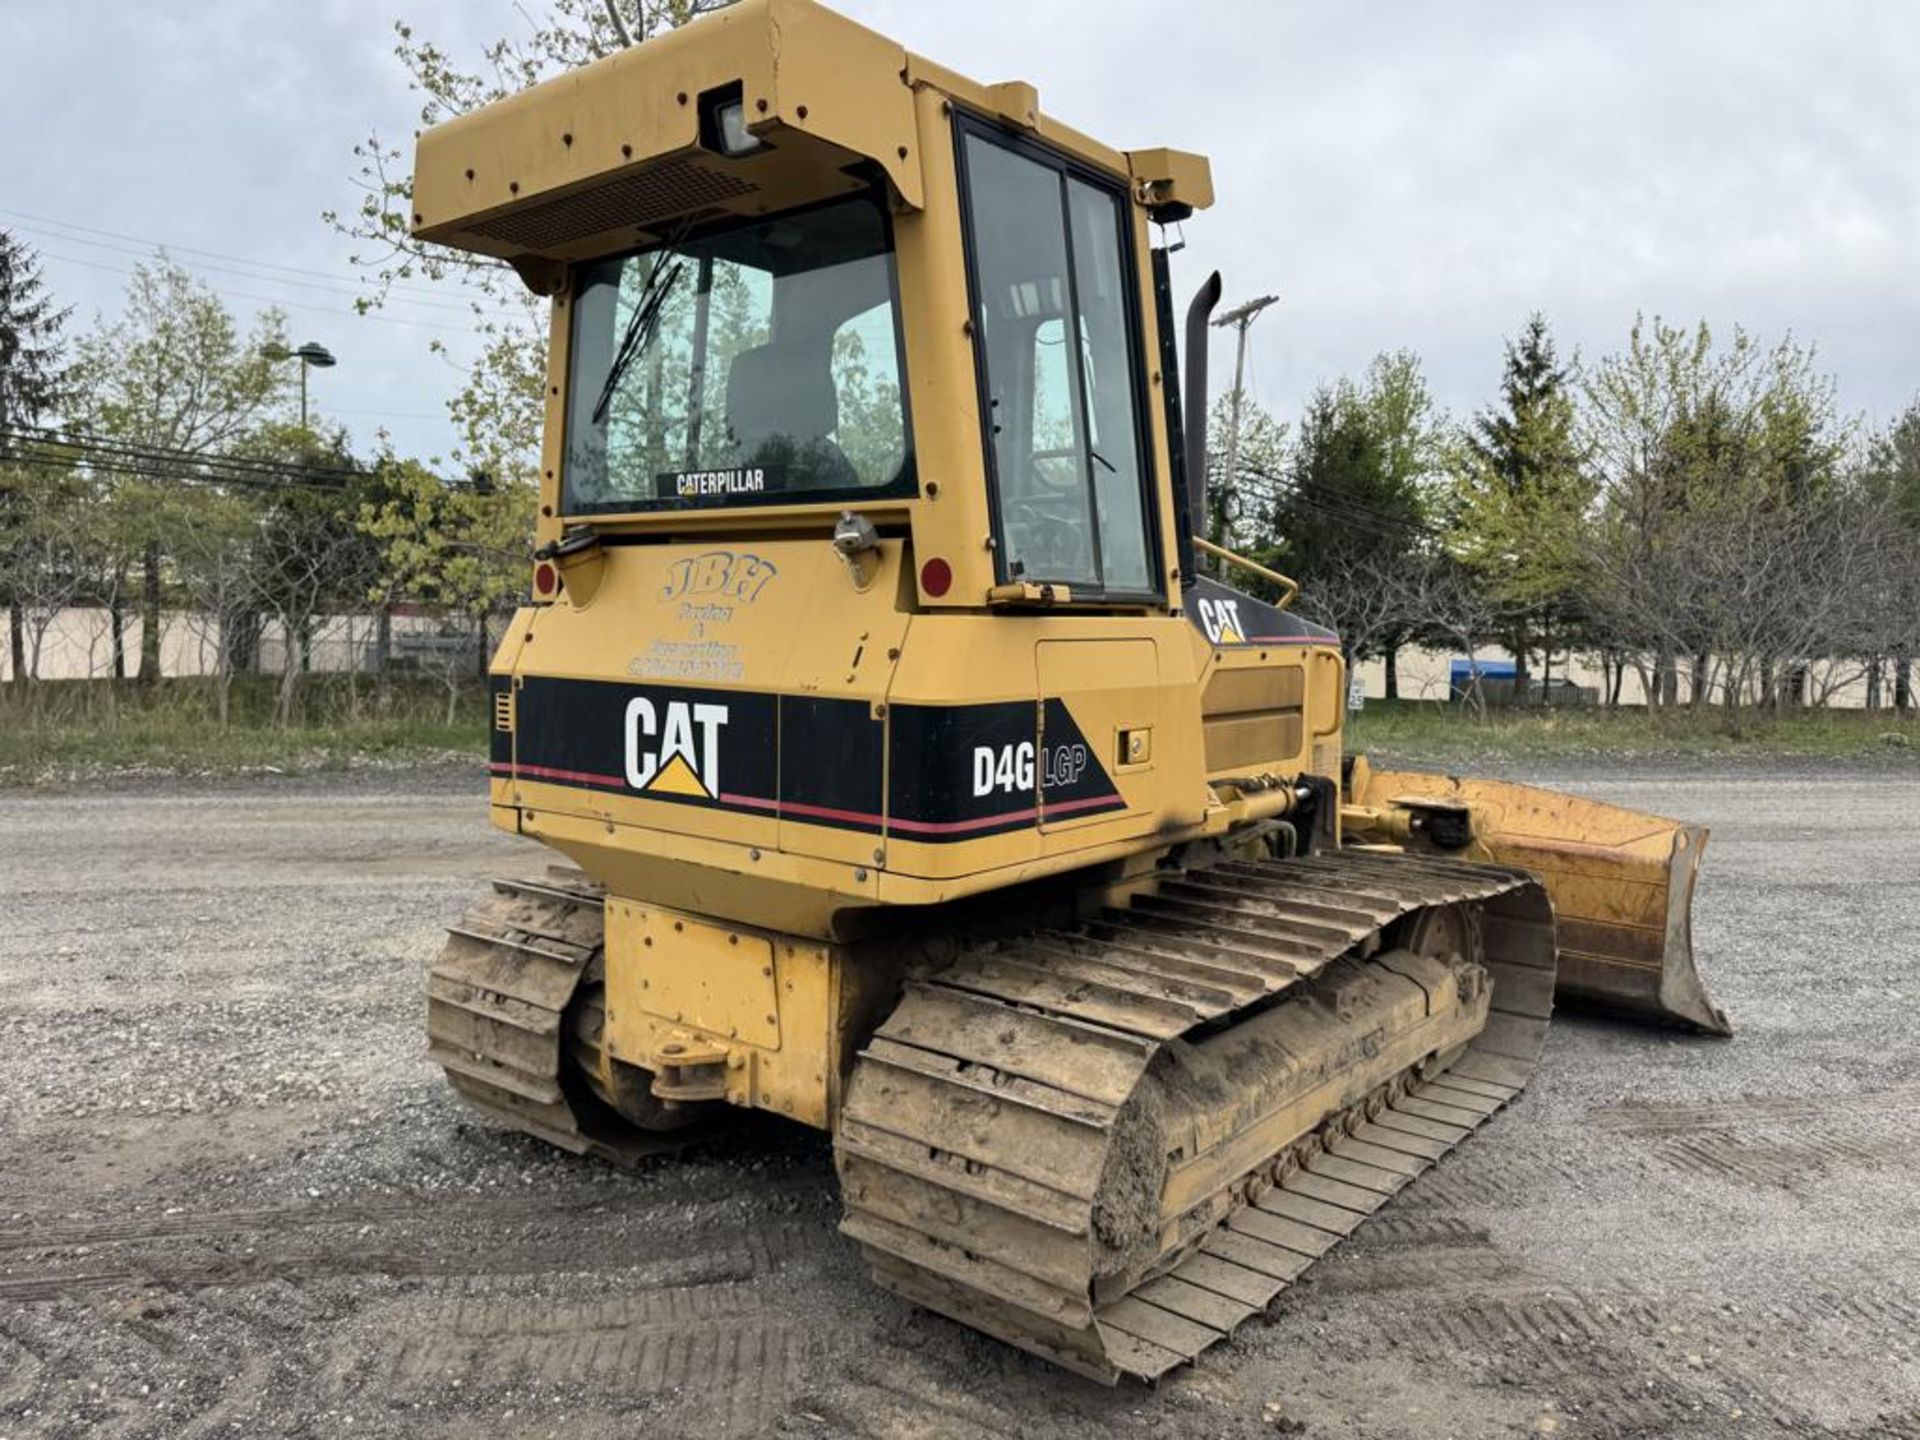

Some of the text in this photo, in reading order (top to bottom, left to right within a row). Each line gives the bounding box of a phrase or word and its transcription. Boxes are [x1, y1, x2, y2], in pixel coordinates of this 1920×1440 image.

[676, 468, 764, 496] CATERPILLAR
[1197, 598, 1247, 643] CAT
[625, 697, 729, 799] CAT
[973, 741, 1086, 797] D4G LGP
